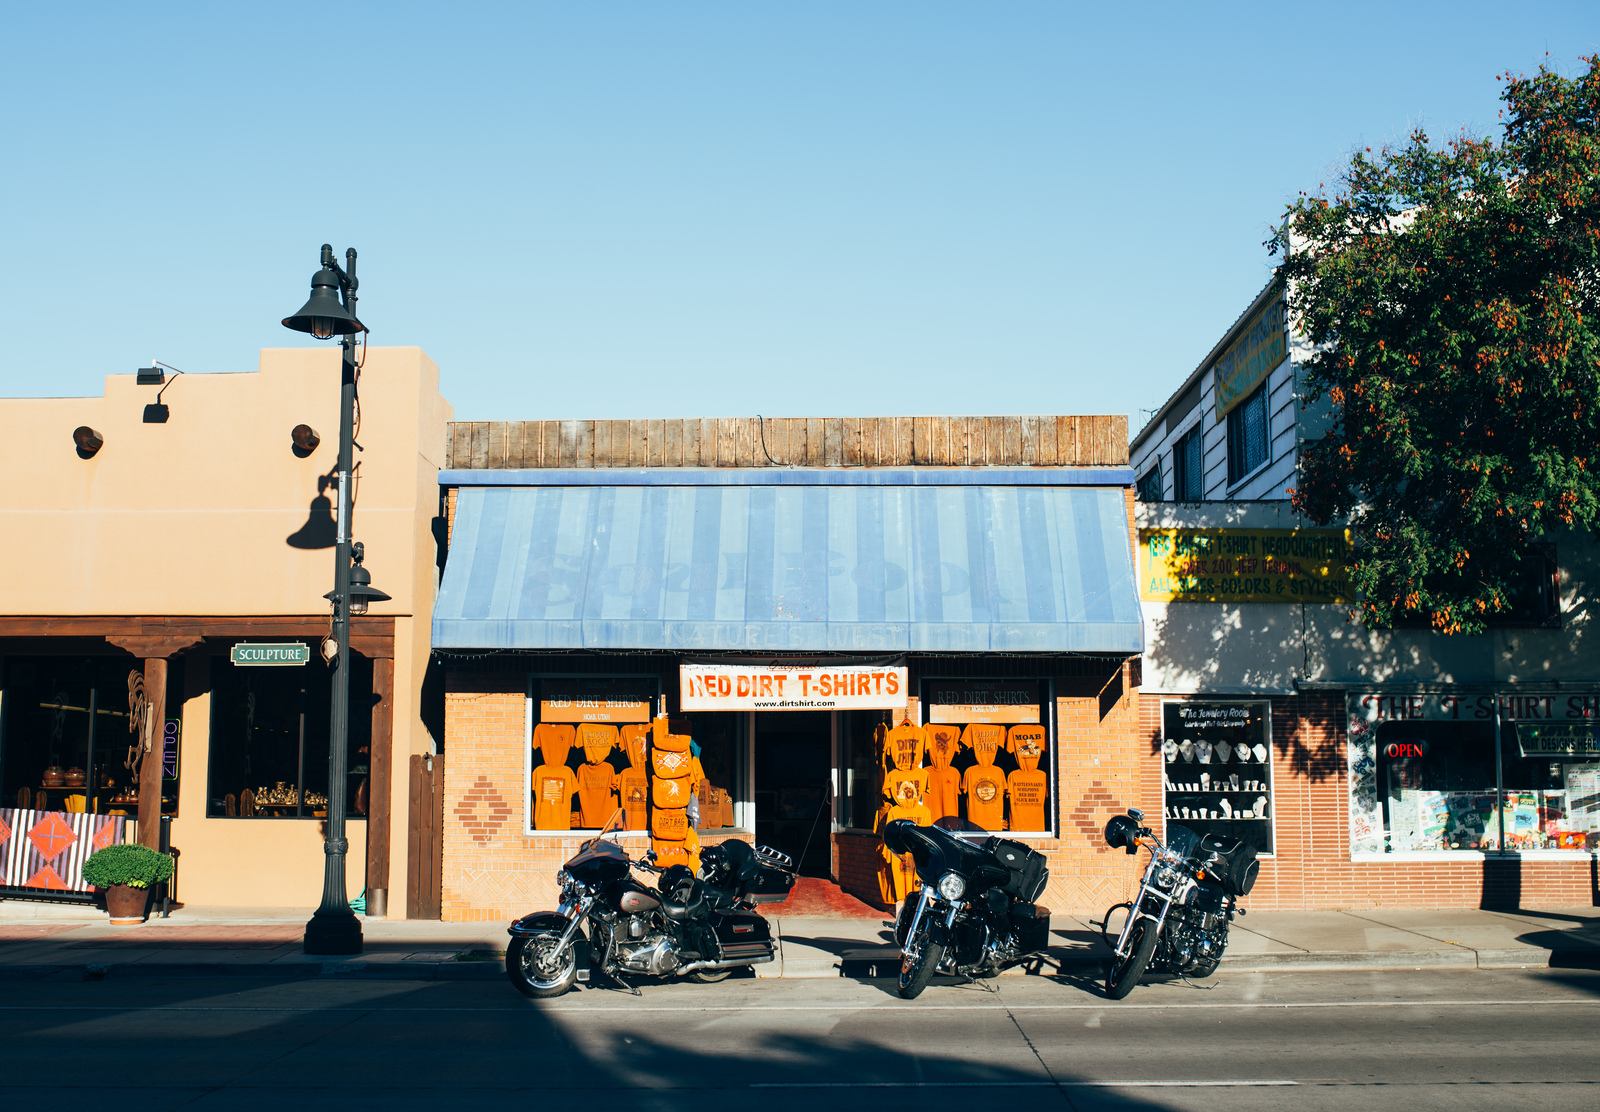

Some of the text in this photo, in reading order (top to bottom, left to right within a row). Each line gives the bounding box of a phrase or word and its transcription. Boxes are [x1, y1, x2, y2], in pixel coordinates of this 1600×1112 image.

[1216, 535, 1257, 554] T-SHIRT
[1212, 559, 1232, 573] 200
[1276, 579, 1286, 594] &
[239, 649, 302, 660] SCULPTURE
[736, 675, 788, 697] DIRT
[798, 671, 899, 697] T-SHIRTS
[550, 694, 641, 708] RED DIRT SHIRTS
[754, 699, 836, 708] www.dirtshirt.com
[938, 691, 1031, 704] RED DIRT SHIRTS
[1362, 695, 1425, 719] THE
[1441, 695, 1556, 719] T-SHIRT
[162, 722, 177, 777] OPEN
[1387, 743, 1423, 758] OPEN
[1541, 738, 1576, 750] DESIGNS
